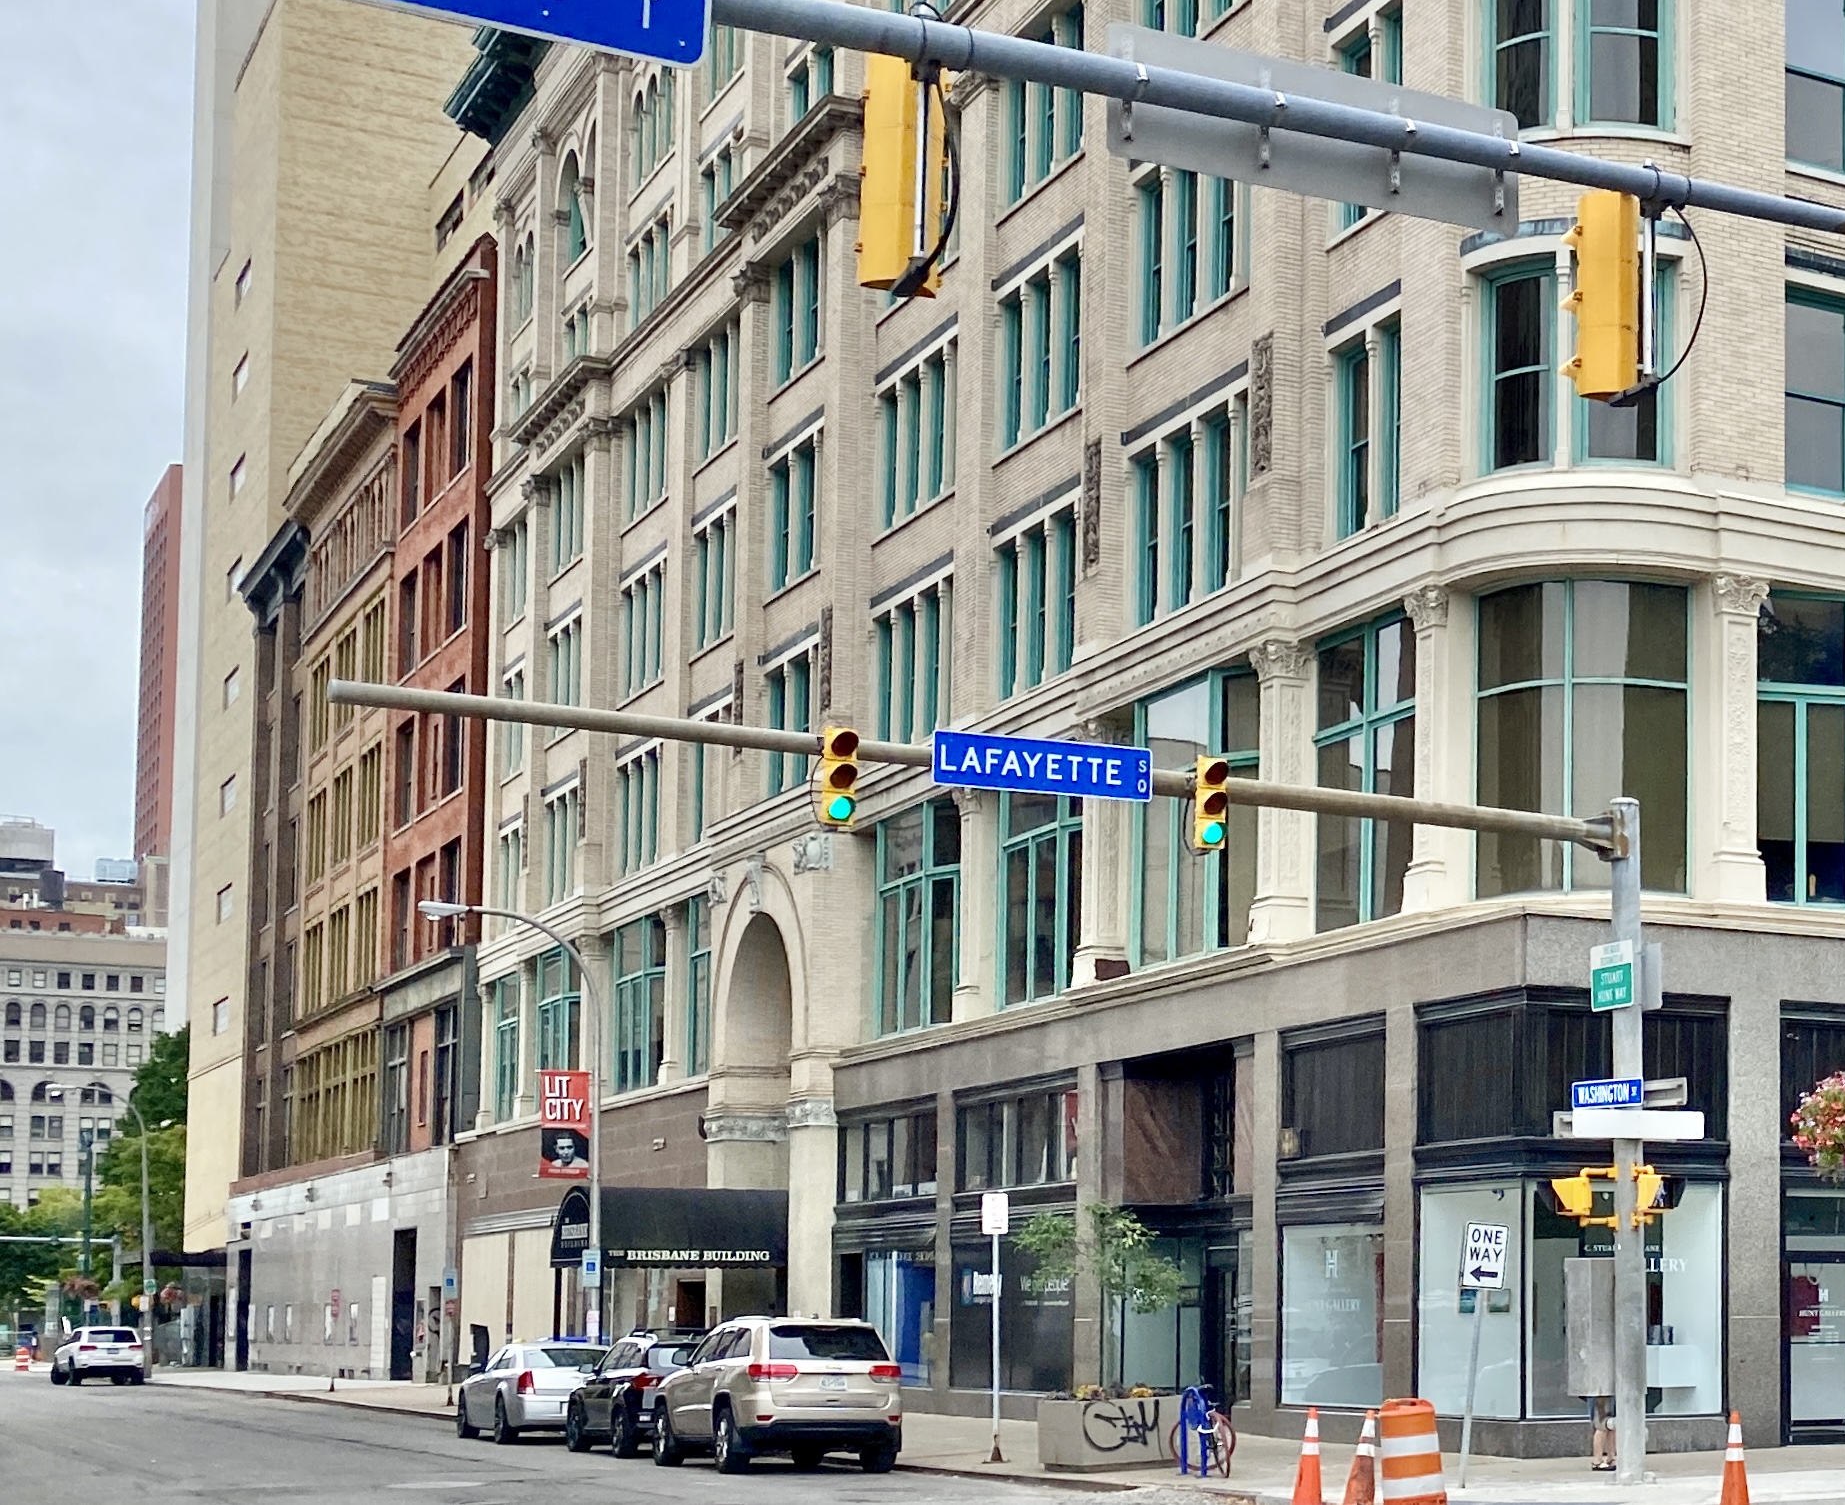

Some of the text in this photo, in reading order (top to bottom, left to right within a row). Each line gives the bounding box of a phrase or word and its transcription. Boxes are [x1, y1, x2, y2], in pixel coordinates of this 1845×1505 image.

[940, 744, 1122, 786] LAFAYETTE
[1601, 970, 1623, 986] STUART
[1614, 986, 1627, 1000] WAY
[544, 1075, 571, 1098] LIT
[1577, 1083, 1630, 1104] WASHINGTON
[545, 1098, 584, 1121] CITY
[1472, 1228, 1503, 1245] ONE
[627, 1249, 700, 1261] BRISBANE
[703, 1250, 770, 1261] BUILDING
[1470, 1247, 1503, 1262] WAY
